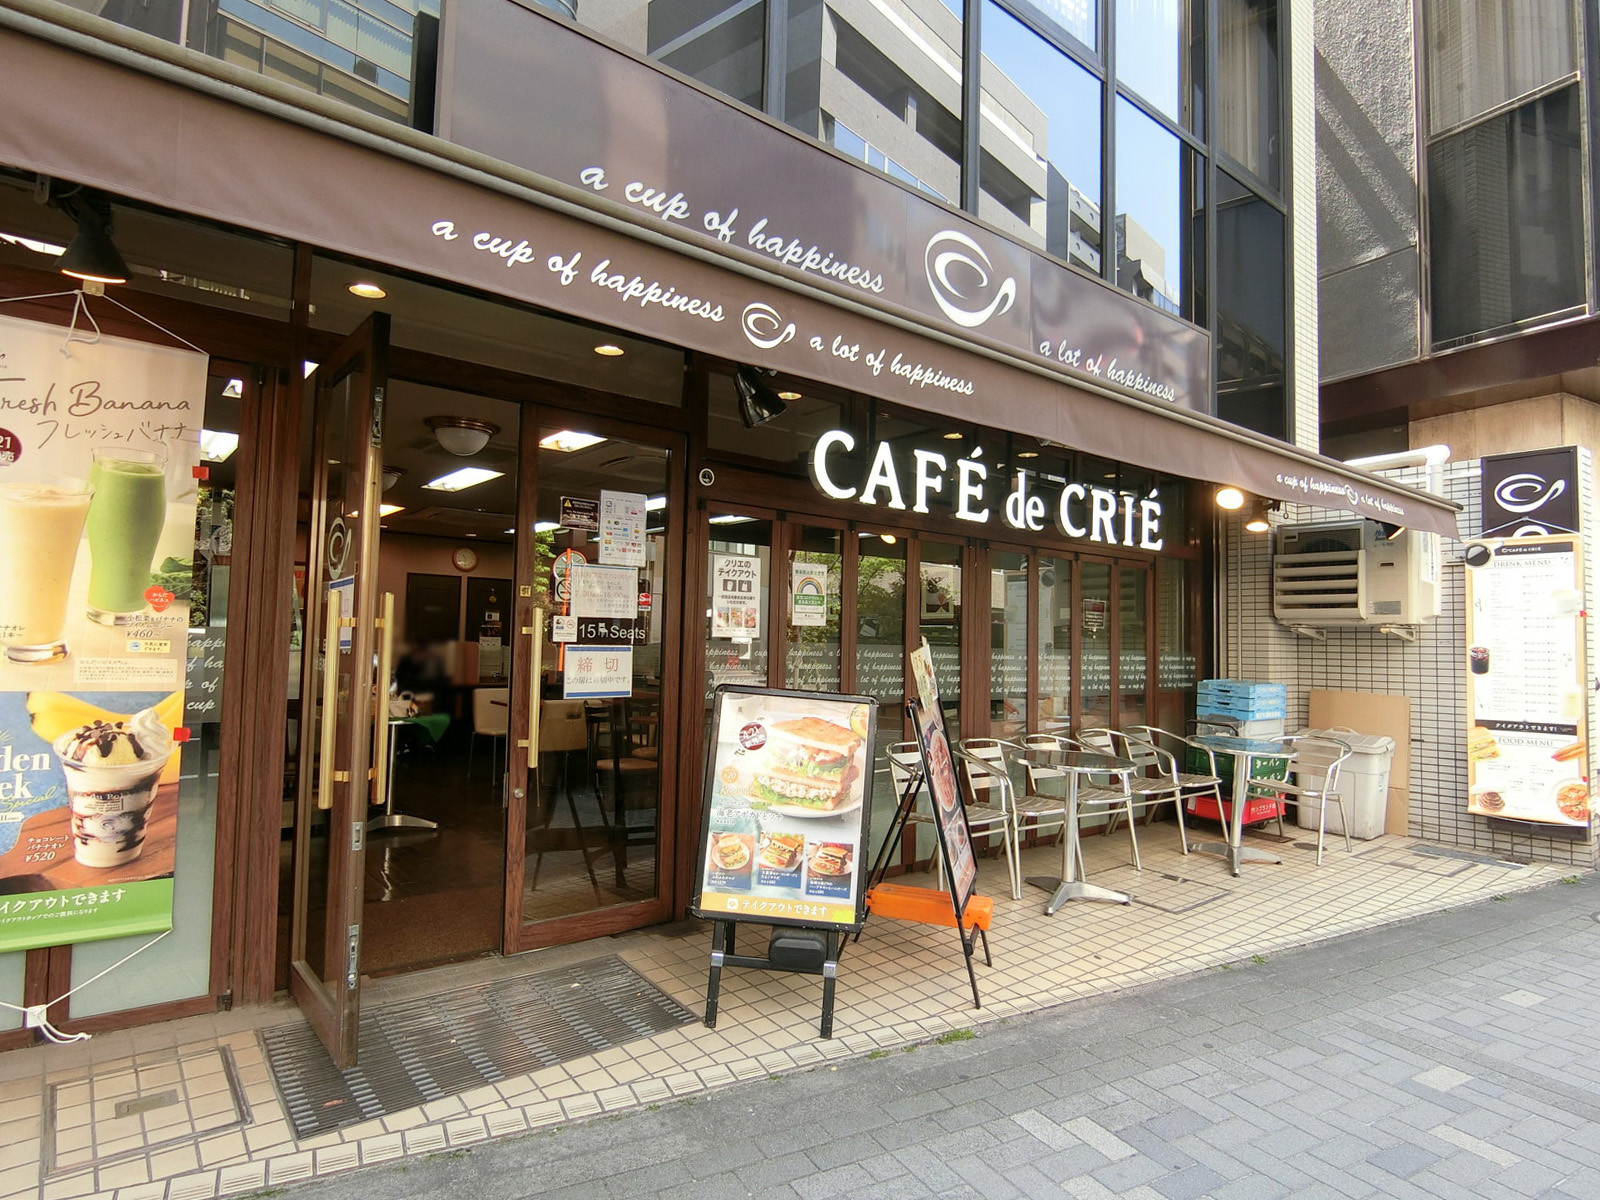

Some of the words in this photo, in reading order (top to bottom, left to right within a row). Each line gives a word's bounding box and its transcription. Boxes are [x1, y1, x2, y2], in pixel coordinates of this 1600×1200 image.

[580, 166, 608, 191] a
[625, 181, 690, 221] cup
[703, 208, 740, 243] of
[748, 218, 885, 293] happiness
[432, 220, 459, 241] a
[472, 232, 535, 268] cup
[547, 252, 582, 287] of
[590, 259, 725, 323] happiness
[809, 334, 824, 351] a
[831, 335, 861, 362] lot
[865, 348, 887, 375] of
[890, 352, 975, 395] happiness
[1039, 339, 1054, 357] a
[1058, 339, 1082, 365] lot
[1086, 353, 1104, 376] of
[1106, 357, 1177, 402] happiness
[0, 378, 57, 416] resh
[68, 380, 191, 417] Banana
[37, 419, 187, 449] フレッシュバナナ
[811, 429, 990, 524] CAFÉ
[1004, 470, 1046, 532] de
[1058, 482, 1164, 552] CRIÉ
[1284, 475, 1299, 491] cup
[1299, 476, 1309, 493] of
[1310, 477, 1346, 496] happiness
[1381, 498, 1405, 516] happiness
[725, 559, 752, 569] クリエの
[1493, 560, 1522, 569] DRINK
[718, 568, 757, 579] テイクアウト
[579, 623, 596, 639] 15
[610, 624, 646, 640] Seats
[706, 649, 738, 660] ppiness
[201, 677, 219, 693] of
[187, 699, 216, 713] cup
[1498, 737, 1525, 745] FOOD
[1527, 739, 1554, 748] MENU
[27, 835, 69, 844] チョコレート
[25, 851, 56, 863] ¥520
[0, 888, 126, 914] イクアウトできます
[742, 899, 828, 916] テイクアウトできます
